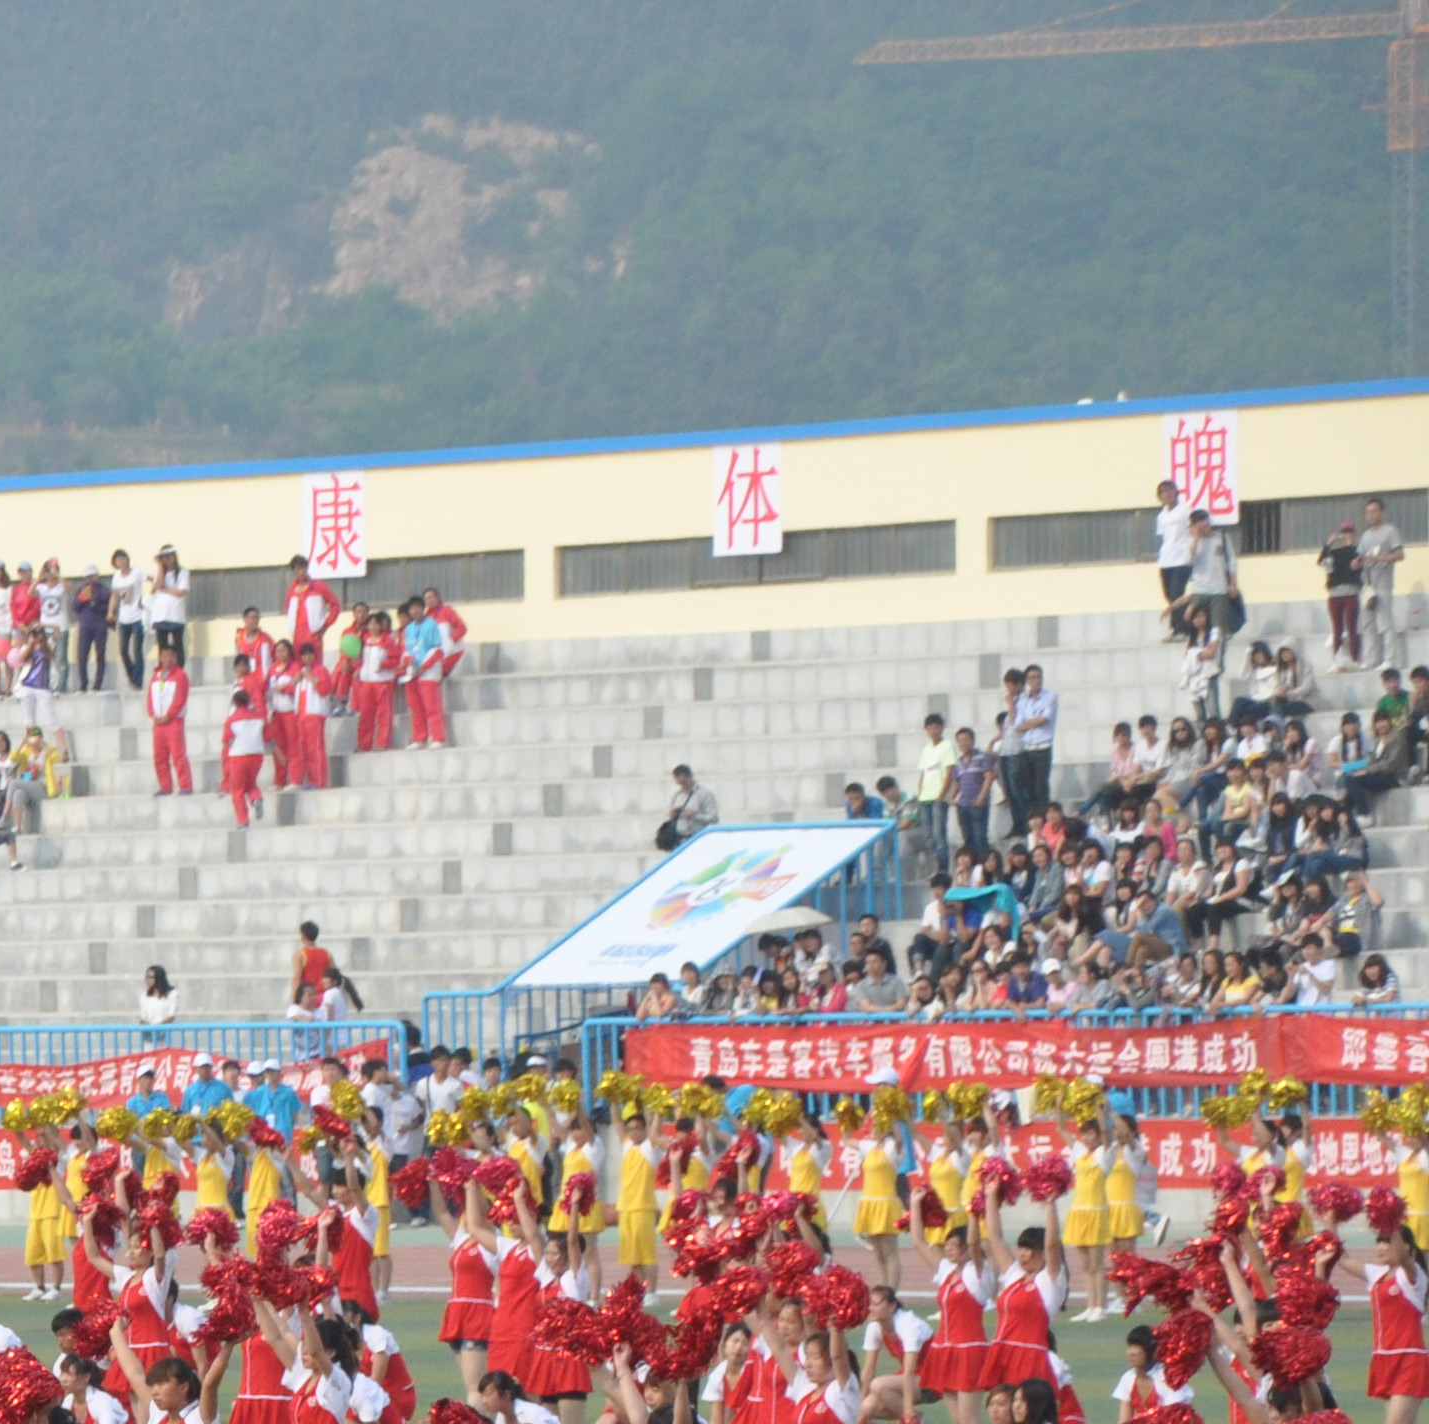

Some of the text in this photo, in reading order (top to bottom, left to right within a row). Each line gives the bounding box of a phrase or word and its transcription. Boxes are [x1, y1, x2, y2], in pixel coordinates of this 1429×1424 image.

[717, 446, 779, 549] 体
[1170, 413, 1235, 516] 魄
[308, 473, 362, 571] 康
